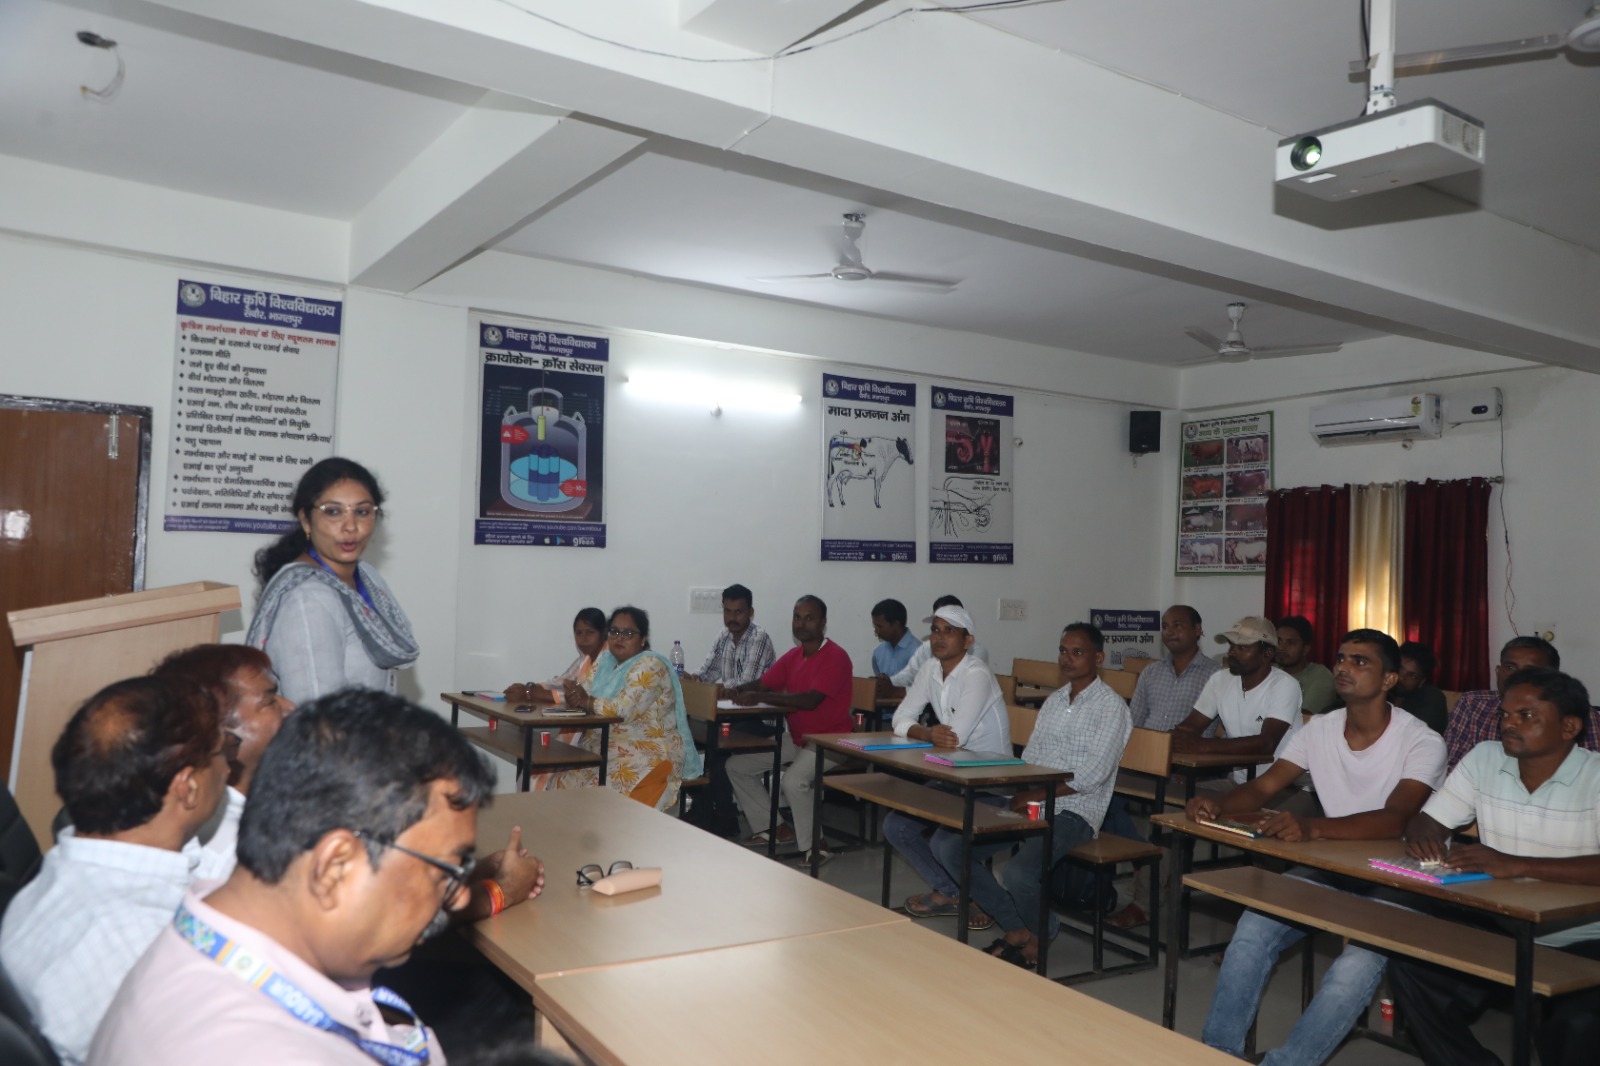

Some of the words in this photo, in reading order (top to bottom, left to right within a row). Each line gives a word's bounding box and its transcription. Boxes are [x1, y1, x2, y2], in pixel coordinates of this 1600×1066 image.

[210, 286, 240, 304] बिहार
[243, 292, 266, 310] कृषि
[270, 295, 335, 317] विश्वविद्यालय
[269, 312, 302, 327] भागलपुर
[206, 323, 236, 334] गर्भाधान
[262, 329, 269, 338] के
[271, 331, 284, 341] लिए
[288, 335, 313, 346] न्यूनतम
[316, 338, 336, 346] मानक
[506, 329, 528, 341] बिहार
[530, 332, 546, 346] कृषि
[549, 334, 596, 349] विश्वविद्यालय
[191, 335, 217, 345] किसानों
[219, 337, 225, 345] के
[263, 342, 280, 353] एआई
[549, 346, 573, 356] भागलपुर
[190, 349, 213, 357] प्रजनन
[215, 349, 231, 358] नीति
[231, 364, 240, 372] की
[542, 357, 566, 369] क्रॉस
[569, 359, 603, 374] सेक्सन
[229, 376, 241, 385] और
[243, 378, 264, 387] वितरण
[841, 382, 857, 390] बिहार
[859, 385, 870, 394] कृषि
[872, 384, 907, 397] विश्वविद्यालय
[187, 398, 205, 407] एआई
[240, 402, 252, 411] और
[255, 402, 272, 412] एआई
[286, 394, 298, 403] और
[300, 395, 320, 405] वितरण
[215, 413, 233, 423] एआई
[278, 417, 287, 427] की
[828, 406, 850, 417] मादा
[855, 409, 888, 421] प्रजनन
[891, 410, 910, 423] अंग
[186, 424, 204, 433] एआई
[235, 427, 241, 435] के
[244, 428, 256, 436] लिए
[259, 430, 278, 438] मानक
[199, 438, 221, 446] पहचान
[218, 451, 230, 459] और
[250, 453, 256, 461] के
[277, 455, 283, 463] के
[285, 456, 297, 465] लिए
[183, 462, 202, 471] एआई
[252, 490, 265, 499] और
[181, 500, 199, 509] एआई
[246, 502, 258, 511] और
[1112, 636, 1137, 644] प्रजनन
[1140, 633, 1153, 643] अंग
